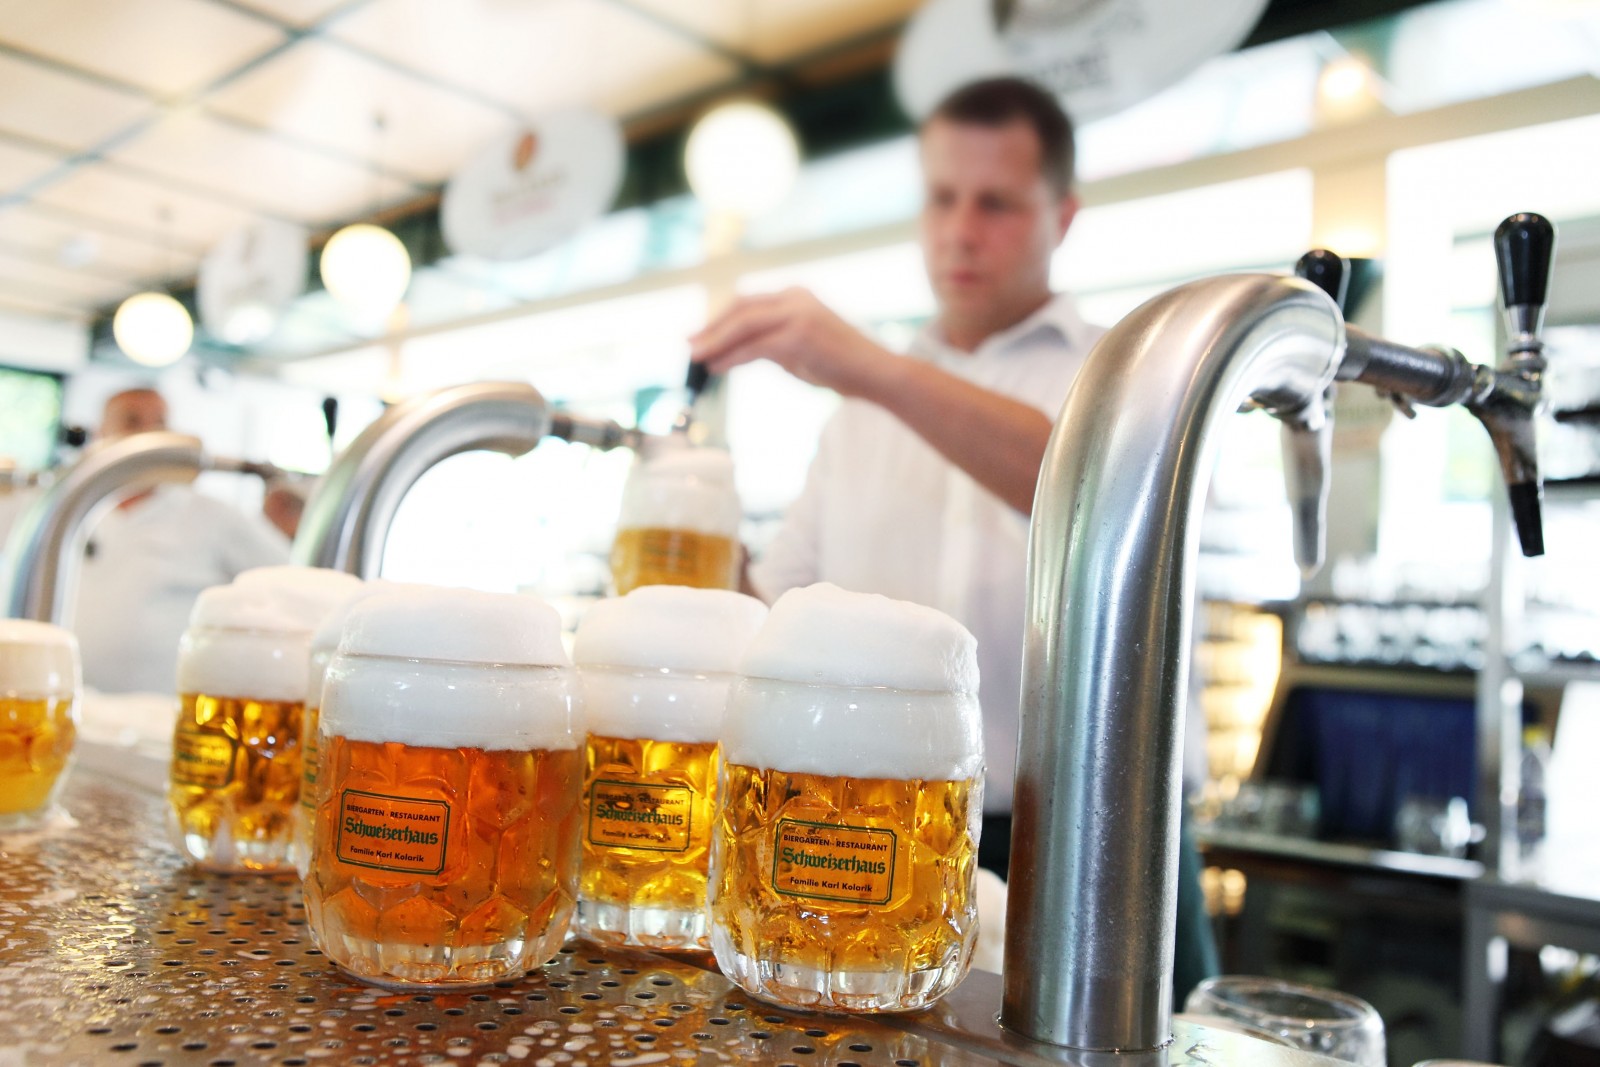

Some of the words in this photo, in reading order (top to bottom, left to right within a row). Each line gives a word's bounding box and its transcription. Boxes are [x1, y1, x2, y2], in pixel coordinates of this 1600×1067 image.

[346, 804, 385, 817] BIERGARTEN
[389, 811, 441, 822] RESTAURANT
[344, 816, 439, 845] Schweizerhaus
[783, 834, 830, 846] BIERGARTEN
[835, 840, 888, 852] RESTAURANT
[350, 845, 375, 856] Familie
[376, 850, 392, 859] Karl
[394, 852, 424, 862] Kolarik
[781, 847, 886, 875] Schweizerhaus
[790, 876, 819, 887] Familie
[821, 880, 840, 889] Karl
[841, 882, 873, 892] Kolarik
